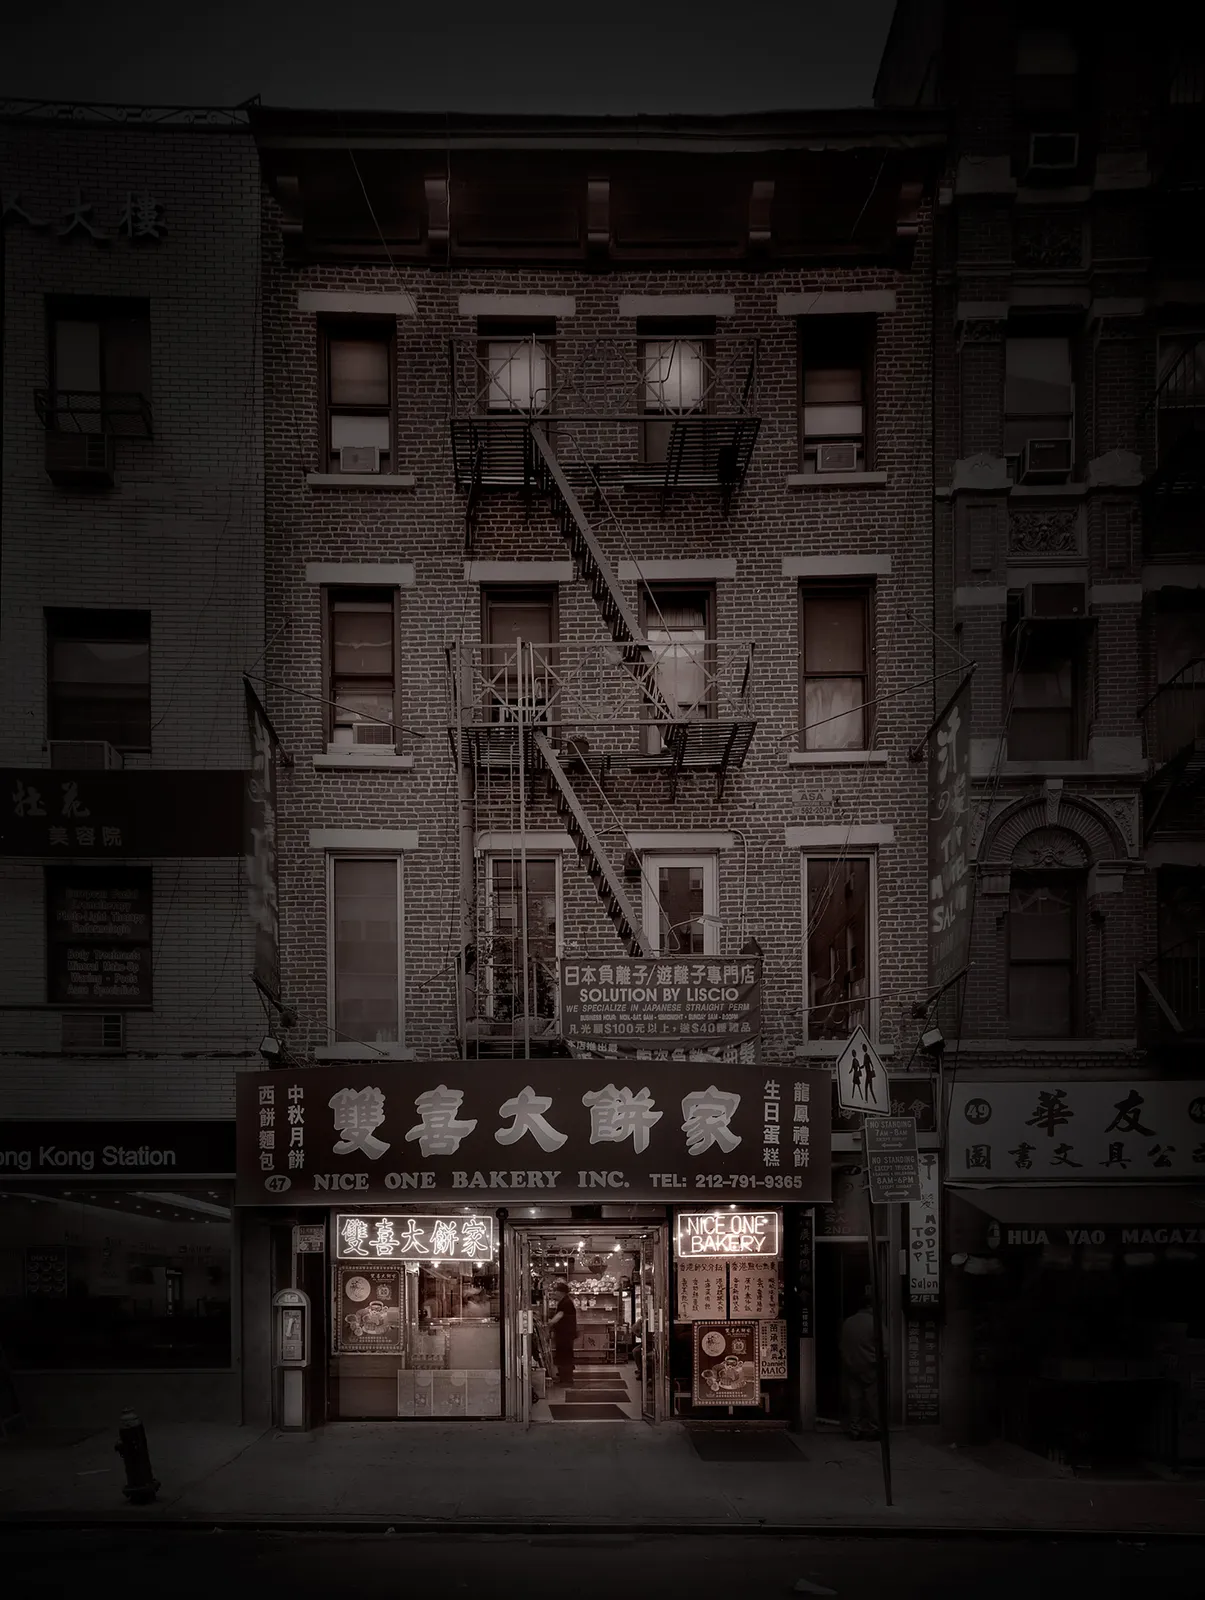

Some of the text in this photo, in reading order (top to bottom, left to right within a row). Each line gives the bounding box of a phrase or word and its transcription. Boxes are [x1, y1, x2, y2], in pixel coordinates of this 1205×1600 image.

[801, 792, 824, 801] ASA
[48, 825, 123, 847] 美容院
[580, 987, 739, 1002] SOLUTION BY LISCIO
[582, 1004, 627, 1012] SPECIALIZE
[630, 1004, 639, 1012] IN
[642, 1003, 681, 1012] JAPANESE
[685, 1003, 725, 1011] STRAIGHT
[728, 1003, 750, 1011] PERM
[967, 1103, 990, 1120] 49
[1025, 1088, 1156, 1138] 華友
[258, 1084, 275, 1171] 西餅麵包
[287, 1084, 305, 1170] 中秋月餅
[328, 1083, 741, 1160] 雙喜大餅家
[763, 1079, 781, 1167] 生日蛋糕
[793, 1081, 810, 1168] 龍鳳禮餅
[870, 1120, 912, 1129] NO STANDING
[40, 1146, 94, 1171] Kong
[102, 1146, 176, 1167] Station
[884, 1156, 915, 1164] STANDING
[268, 1177, 287, 1191] 47
[313, 1171, 803, 1191] NICE ONE BAKERY INC. TEL: 212-791-9365
[688, 1215, 765, 1235] NICE ONE
[824, 1226, 851, 1234] 2ND
[341, 1217, 489, 1258] 雙喜大餅家
[692, 1234, 766, 1253] BAKERY
[1008, 1229, 1049, 1245] HUA
[1065, 1229, 1105, 1245] YAO
[911, 1277, 938, 1289] Salon
[761, 1366, 786, 1375] MAIO
